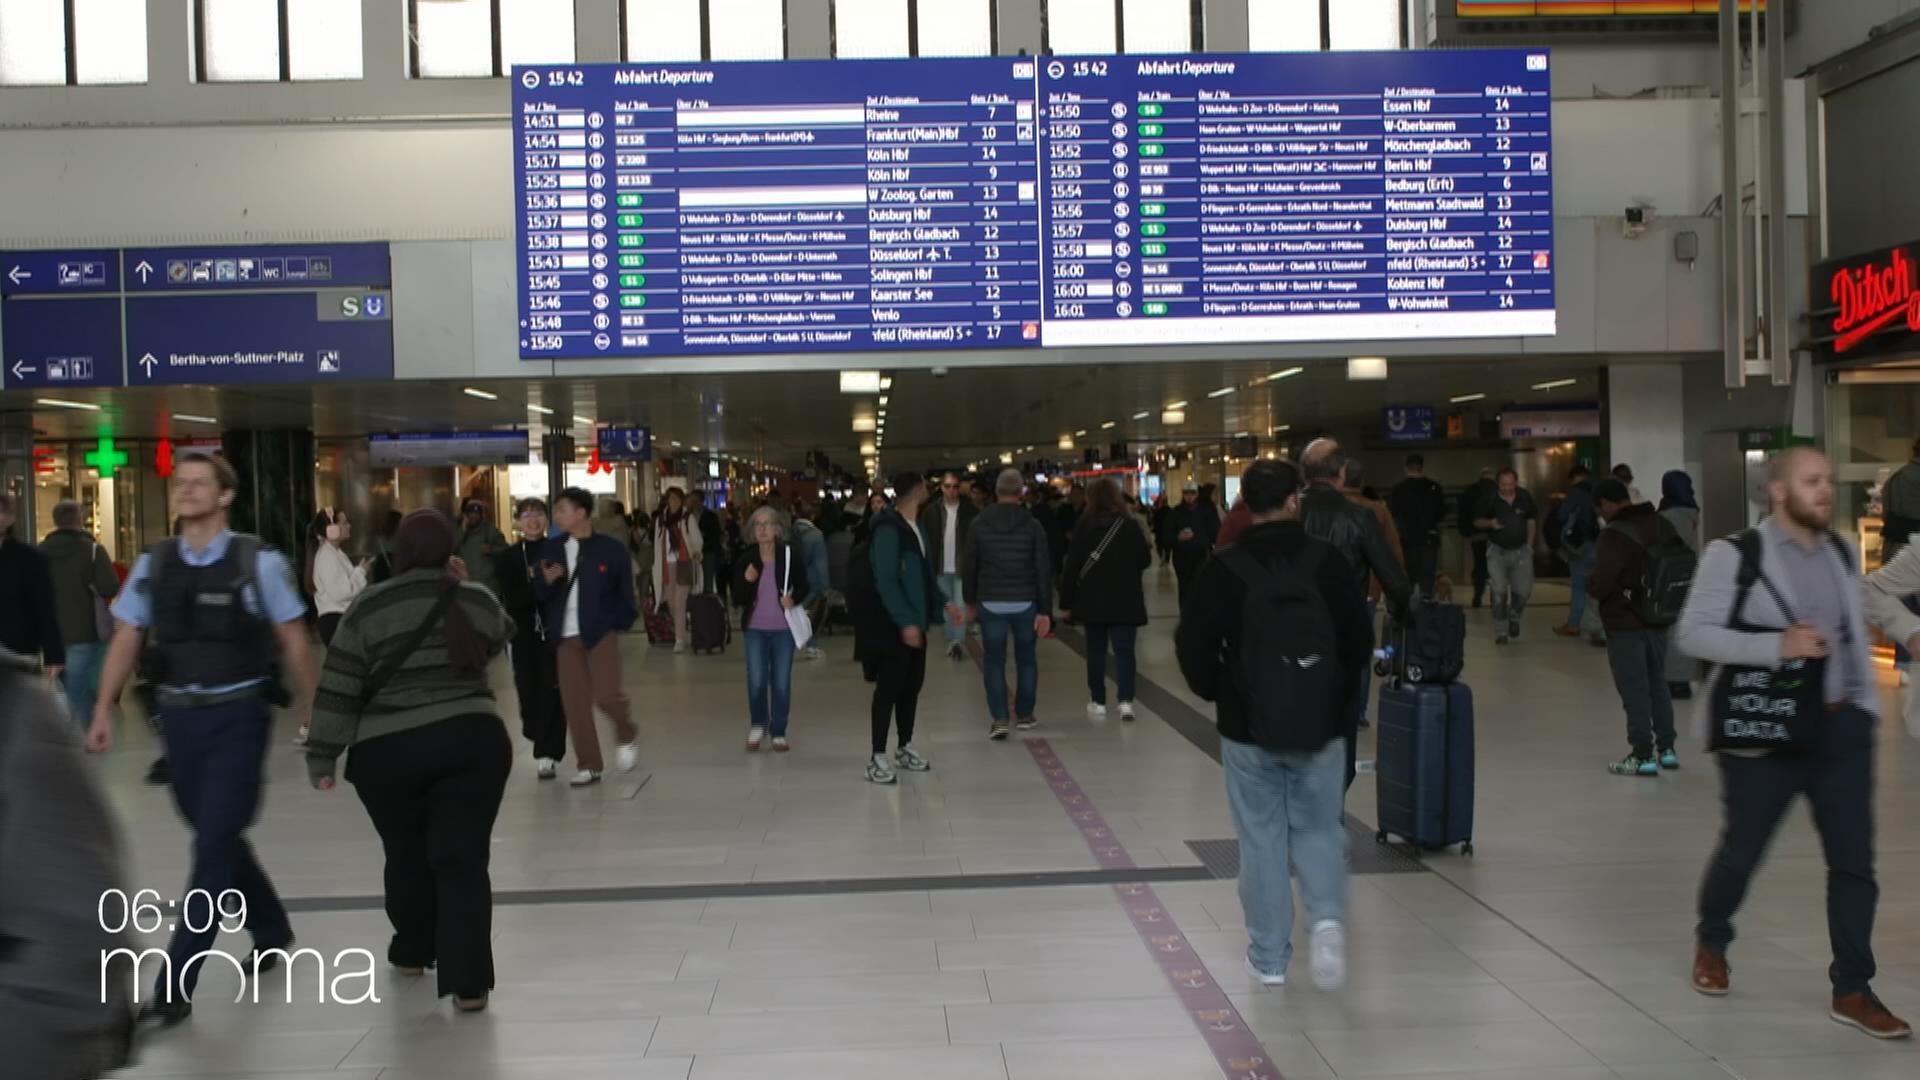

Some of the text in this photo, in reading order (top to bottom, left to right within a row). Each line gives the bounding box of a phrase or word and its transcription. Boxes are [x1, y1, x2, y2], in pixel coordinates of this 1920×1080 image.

[1526, 54, 1547, 70] DB
[1073, 62, 1108, 76] 15 42
[1138, 60, 1235, 78] Abfahrt Departure
[548, 70, 584, 86] 15 42
[614, 69, 714, 87] Abfahrt Departure
[1384, 100, 1430, 112] Essen Hbf
[1496, 99, 1509, 110] 14
[866, 109, 900, 122] Rheine
[988, 108, 995, 120] 7
[1050, 105, 1080, 118] 15:50
[524, 115, 555, 128] 14:51
[1384, 120, 1456, 132] W-Oberbarmen
[1496, 119, 1510, 130] 13
[982, 128, 996, 140] 10
[1050, 125, 1081, 138] 15:50
[525, 135, 555, 148] 14:54
[1384, 138, 1471, 154] Mönchengladbach
[1496, 138, 1510, 150] 12
[867, 148, 909, 162] Köln Hbf
[983, 148, 996, 160] 14
[1051, 145, 1081, 158] 15:52
[526, 155, 556, 169] 15:17
[1385, 158, 1432, 172] Berlin Hbf
[1503, 157, 1511, 170] 9
[868, 168, 910, 182] Köln Hbf
[989, 168, 997, 180] 9
[1051, 165, 1081, 178] 15:53
[1385, 178, 1454, 193] Bedburg (Erft)
[1503, 178, 1511, 189] 6
[868, 189, 878, 201] W
[920, 187, 953, 200] Garten
[984, 188, 998, 200] 13
[1052, 185, 1082, 198] 15:54
[1386, 198, 1484, 211] Mettmann Stadtwald
[1498, 198, 1511, 209] 13
[869, 208, 931, 222] Duisburg Hbf
[984, 208, 998, 220] 14
[1052, 205, 1082, 218] 15:56
[528, 216, 558, 229] 15:37
[1386, 218, 1446, 232] Duisburg Hbf
[1498, 217, 1511, 229] 14
[870, 228, 960, 242] Bergisch Gladbach
[984, 228, 998, 240] 12
[1053, 225, 1083, 238] 15:57
[528, 236, 559, 249] 15:38
[1386, 237, 1474, 252] Bergisch Gladbach
[1498, 236, 1512, 248] 12
[870, 249, 922, 262] Düsseldorf
[985, 247, 999, 259] 13
[1053, 245, 1083, 258] 15:58
[529, 256, 559, 269] 15:43
[1414, 257, 1469, 271] (Rheinland)
[1499, 256, 1512, 268] 17
[264, 268, 279, 278] WC
[871, 268, 932, 284] Solingen Hbf
[986, 268, 999, 279] 11
[1054, 265, 1084, 278] 16:00
[529, 276, 560, 289] 15:45
[1388, 277, 1444, 290] Koblenz Hbf
[1506, 276, 1513, 288] 4
[871, 288, 933, 301] Kaarster See
[986, 287, 1000, 299] 12
[1054, 285, 1084, 298] 16:00
[1832, 248, 1908, 332] Ditsch
[343, 297, 381, 316] S U
[530, 296, 561, 309] 15:46
[1388, 297, 1448, 310] W-Vohwinkel
[1500, 296, 1513, 308] 14
[872, 308, 900, 322] Venlo
[993, 307, 1000, 319] 5
[1055, 305, 1084, 318] 16:01
[530, 316, 562, 330] 15:48
[898, 328, 954, 342] (Rheinland)
[987, 328, 1001, 340] 17
[531, 336, 562, 350] 15:50
[170, 352, 304, 366] Bertha-von-Suttner-Platz
[1728, 693, 1798, 717] YOUR
[1723, 718, 1792, 741] DATA
